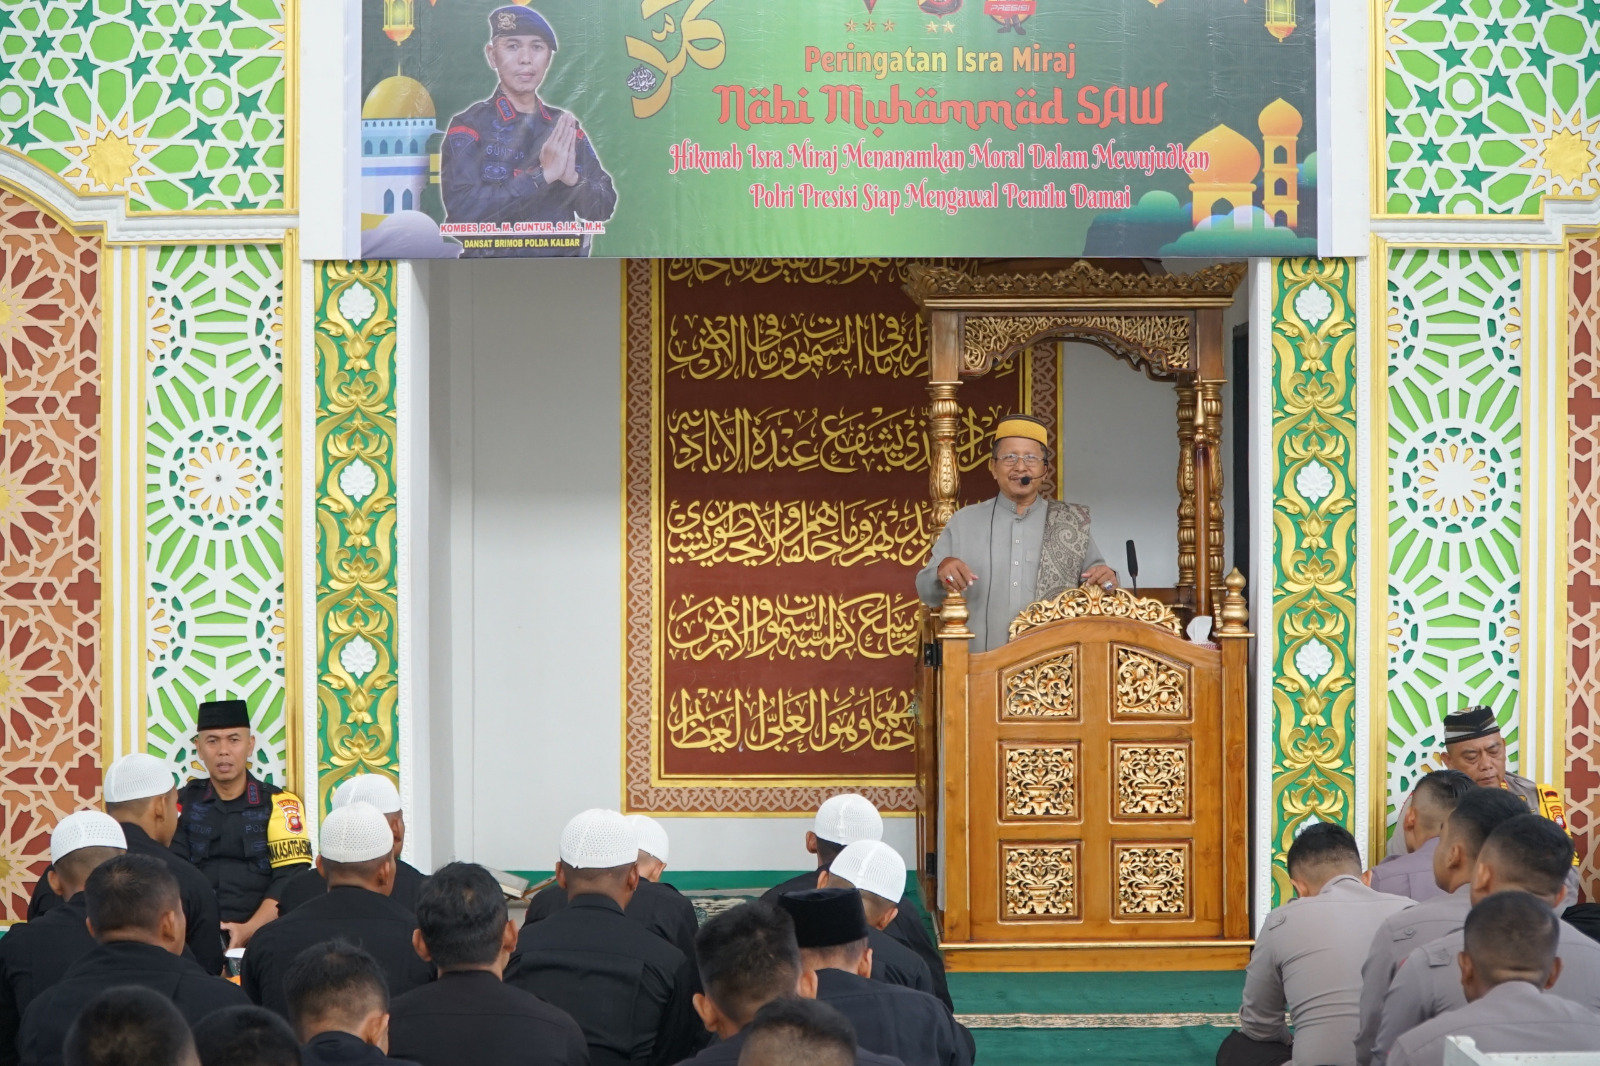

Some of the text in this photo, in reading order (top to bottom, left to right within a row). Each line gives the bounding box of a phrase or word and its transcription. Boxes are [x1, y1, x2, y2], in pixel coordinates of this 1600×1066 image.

[989, 3, 1030, 13] PRESISI
[804, 43, 1076, 79] Peringatan Isra Miraj
[1077, 82, 1169, 129] SAW
[669, 138, 1210, 176] Hikmah Isra Miraj Menanamkan Moral Dalam Mewujudkan
[749, 178, 1131, 216] Polri Presisi Siap Mengawal Pemilu Damai
[440, 223, 478, 233] KOMBES
[480, 223, 500, 232] POL.
[502, 223, 512, 232] M.
[514, 222, 555, 233] GUNTUR,
[585, 222, 605, 231] M.H.
[464, 238, 580, 248] DANSAT BRIMOB POLDA KALBAR
